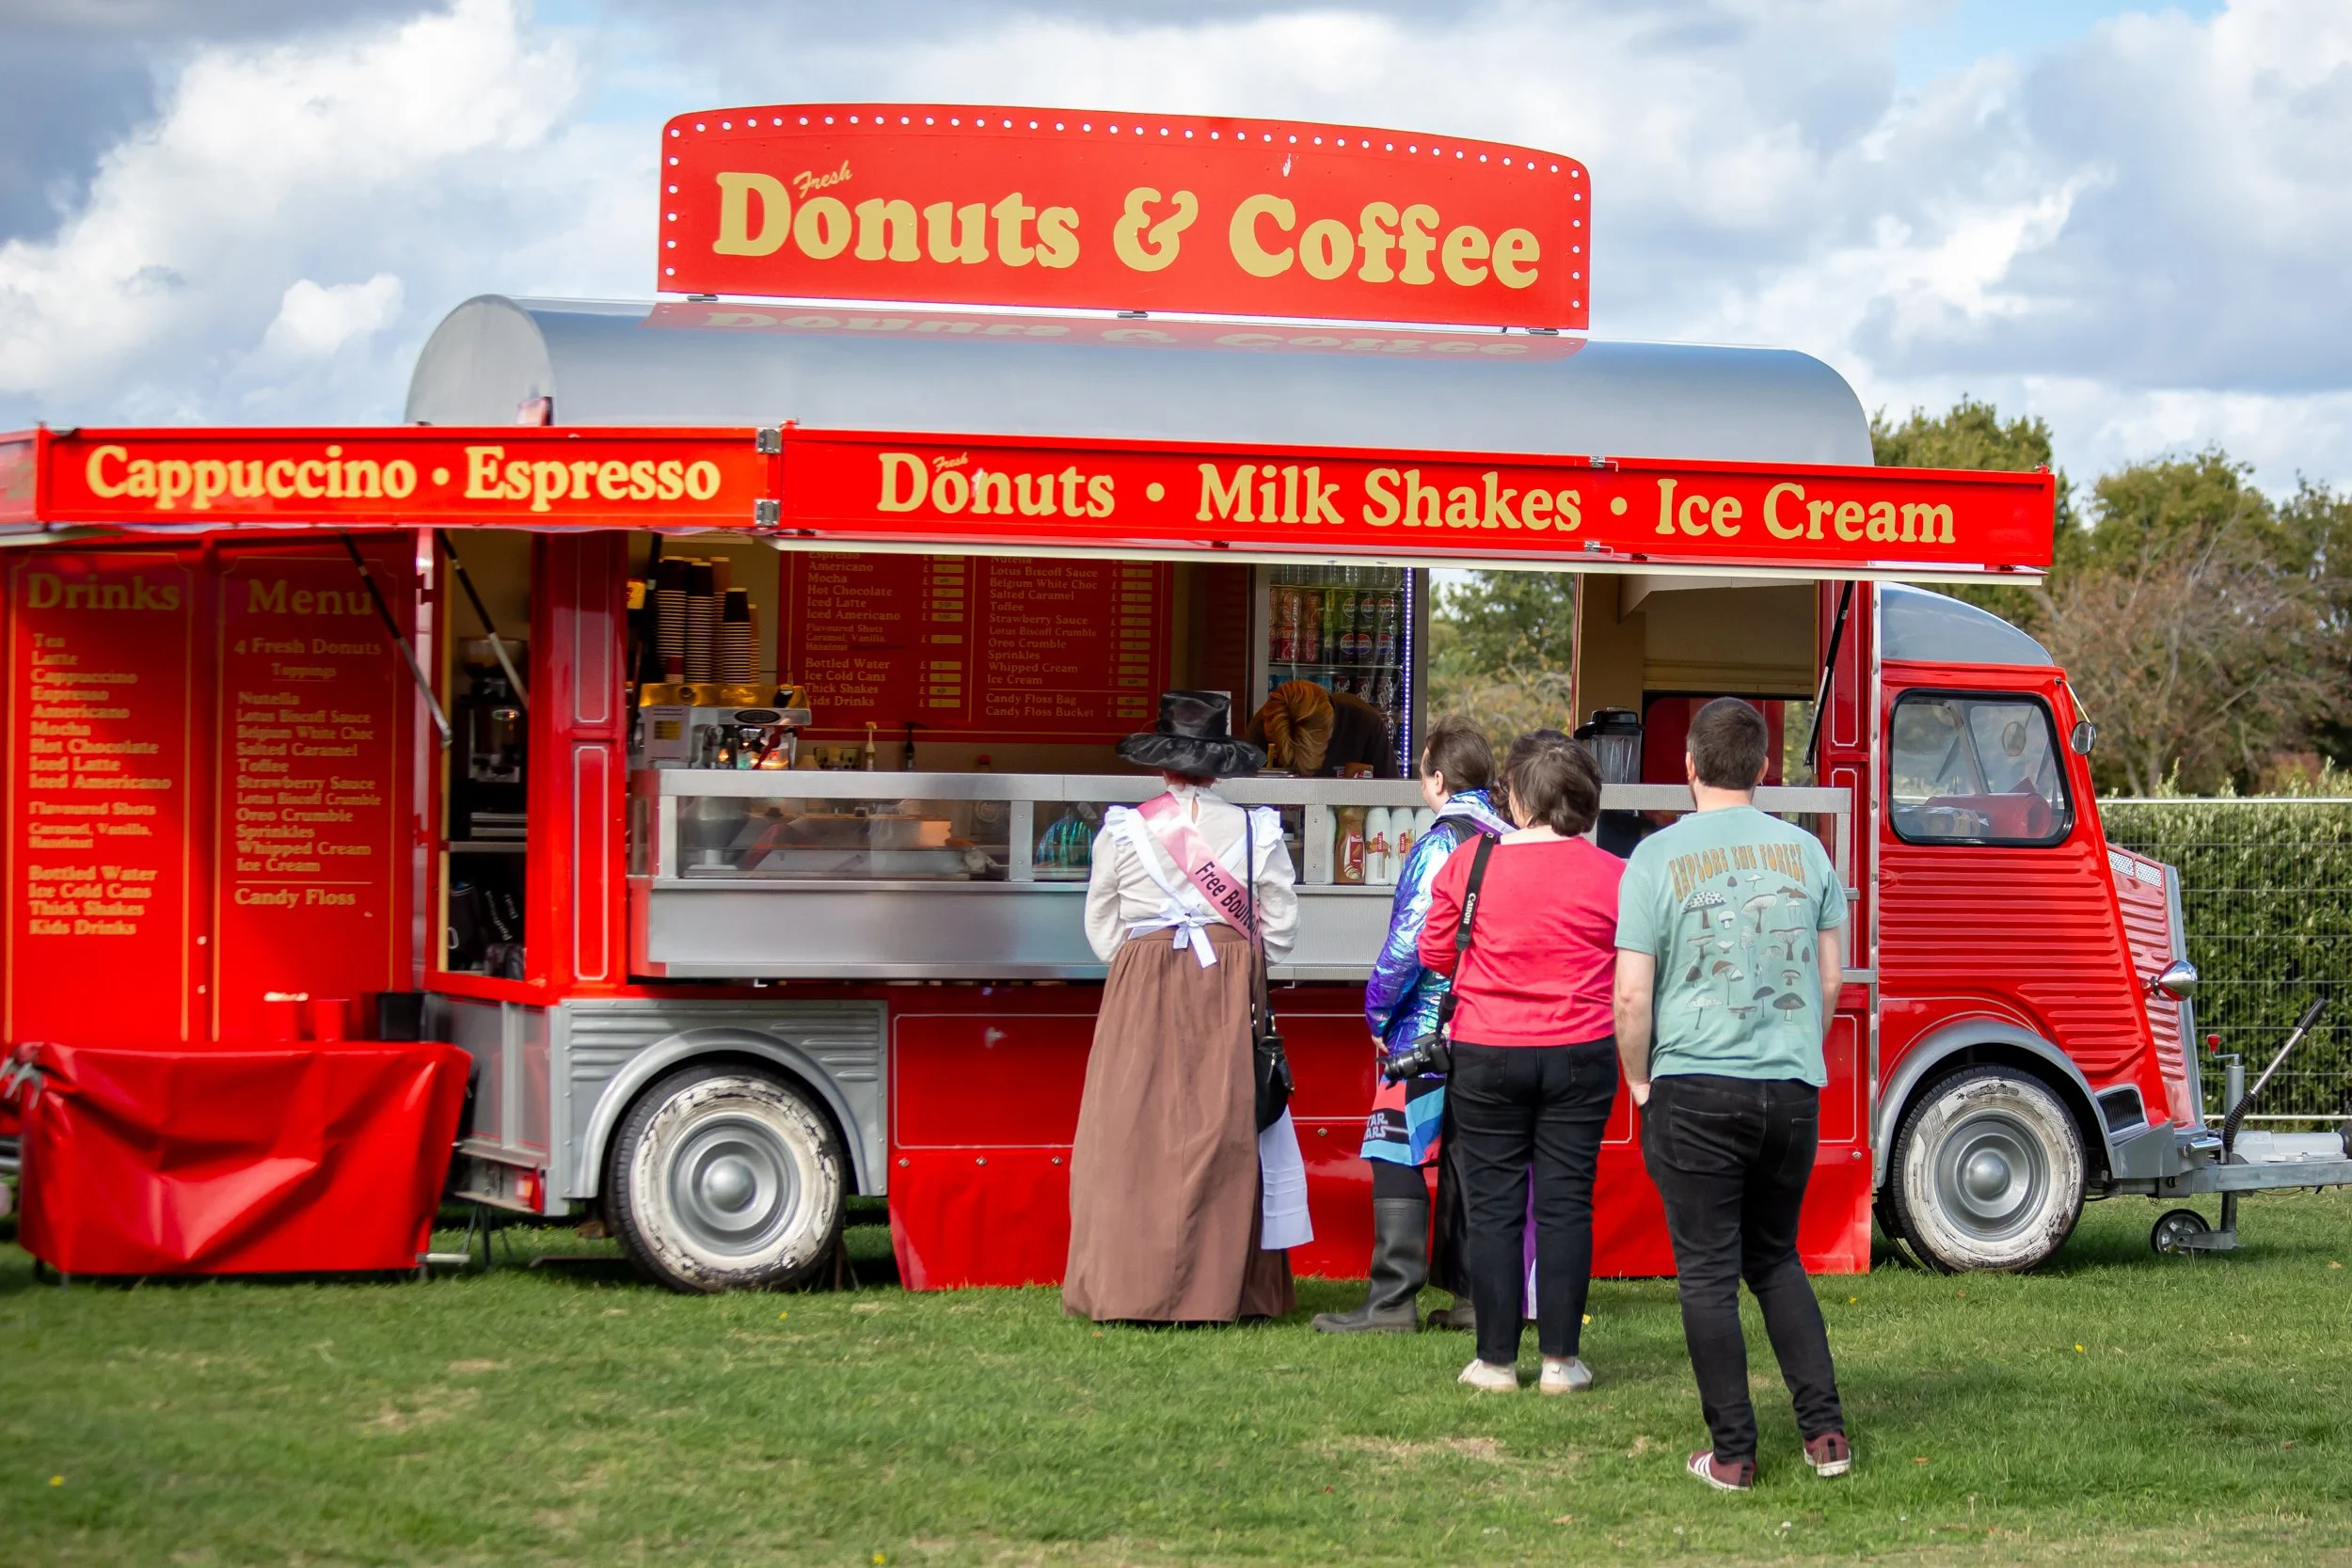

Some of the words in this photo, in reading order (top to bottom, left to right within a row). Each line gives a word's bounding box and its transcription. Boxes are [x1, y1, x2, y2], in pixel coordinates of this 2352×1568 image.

[793, 160, 853, 198] Fresh
[712, 171, 1080, 269] Donuts
[1113, 187, 1199, 272] &
[1229, 193, 1540, 289] Coffee
[932, 451, 969, 473] Fresh
[86, 445, 418, 510] Cappuccino
[465, 446, 723, 514] Espresso
[876, 451, 1116, 518] Donuts
[1195, 463, 1345, 524] Milk
[1361, 468, 1582, 533] Shakes
[1655, 478, 1742, 538] Ice
[1763, 483, 1956, 546] Cream
[808, 562, 873, 572] Americano
[991, 565, 1022, 576] Lotus
[1025, 567, 1062, 577] Biscoff
[1065, 567, 1098, 578] Sauce
[807, 573, 848, 583] Mocha
[990, 578, 1032, 589] Belgium
[1037, 578, 1068, 589] White
[1072, 579, 1097, 590] Choc
[26, 572, 181, 610] Drinks
[246, 578, 374, 615] Menu
[807, 585, 828, 594] Hot
[834, 585, 893, 596] Chocolate
[989, 590, 1025, 599] Salted
[1028, 591, 1074, 600] Caramel
[807, 596, 832, 607] Iced
[836, 597, 866, 608] Latte
[990, 602, 1024, 611] Toffee
[807, 609, 831, 619] Iced
[835, 610, 900, 621] Americano
[989, 614, 1052, 626] Strawberry
[1056, 615, 1089, 625] Sauce
[806, 624, 853, 632] Flavoured
[857, 625, 883, 633] Shots
[989, 626, 1016, 636] Lotus
[1020, 626, 1052, 637] Biscoff
[1055, 627, 1097, 638] Crumble
[311, 639, 382, 655] Donuts
[805, 642, 848, 651] Hazelnut
[988, 639, 1015, 648] Oreo
[1019, 639, 1067, 649] Crumble
[987, 650, 1041, 660] Sprinkles
[805, 657, 849, 668] Bottled
[854, 658, 890, 669] Water
[988, 662, 1038, 673] Whipped
[1042, 663, 1078, 673] Cream
[805, 671, 822, 680] Ice
[826, 671, 852, 681] Cold
[857, 671, 886, 681] Cans
[987, 674, 1003, 684] Ice
[1007, 675, 1043, 684] Cream
[805, 683, 836, 692] Thick
[840, 684, 879, 693] Shakes
[834, 696, 875, 706] Drinks
[986, 693, 1021, 705] Candy
[1025, 694, 1053, 704] Floss
[1057, 694, 1077, 705] Bag
[985, 706, 1021, 718] Candy
[1025, 707, 1052, 717] Floss
[1056, 707, 1094, 718] Bucket
[1195, 861, 1226, 897] Free
[1669, 847, 1729, 904] EXPLORE
[1463, 892, 1477, 925] Canon
